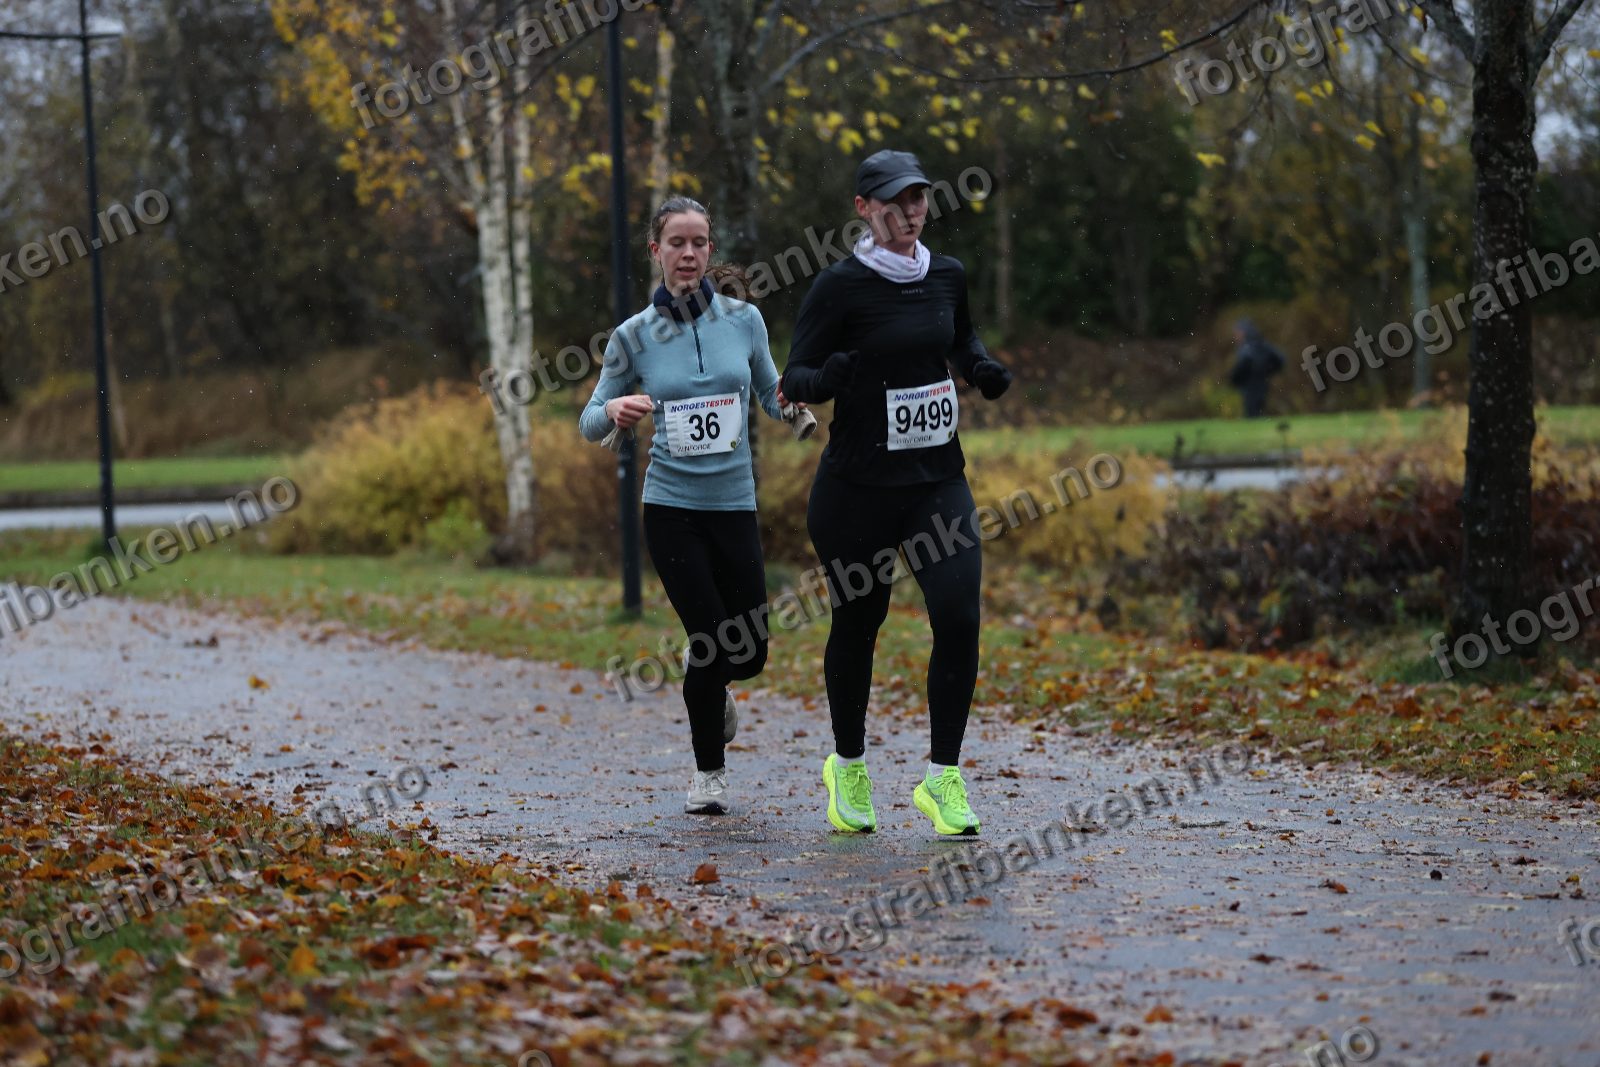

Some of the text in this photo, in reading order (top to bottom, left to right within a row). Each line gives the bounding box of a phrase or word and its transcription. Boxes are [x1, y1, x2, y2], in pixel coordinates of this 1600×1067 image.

[895, 385, 951, 401] NORGESTESTEN
[671, 398, 734, 413] NORGESTESTEN
[895, 397, 953, 434] 9499
[689, 411, 720, 441] 36
